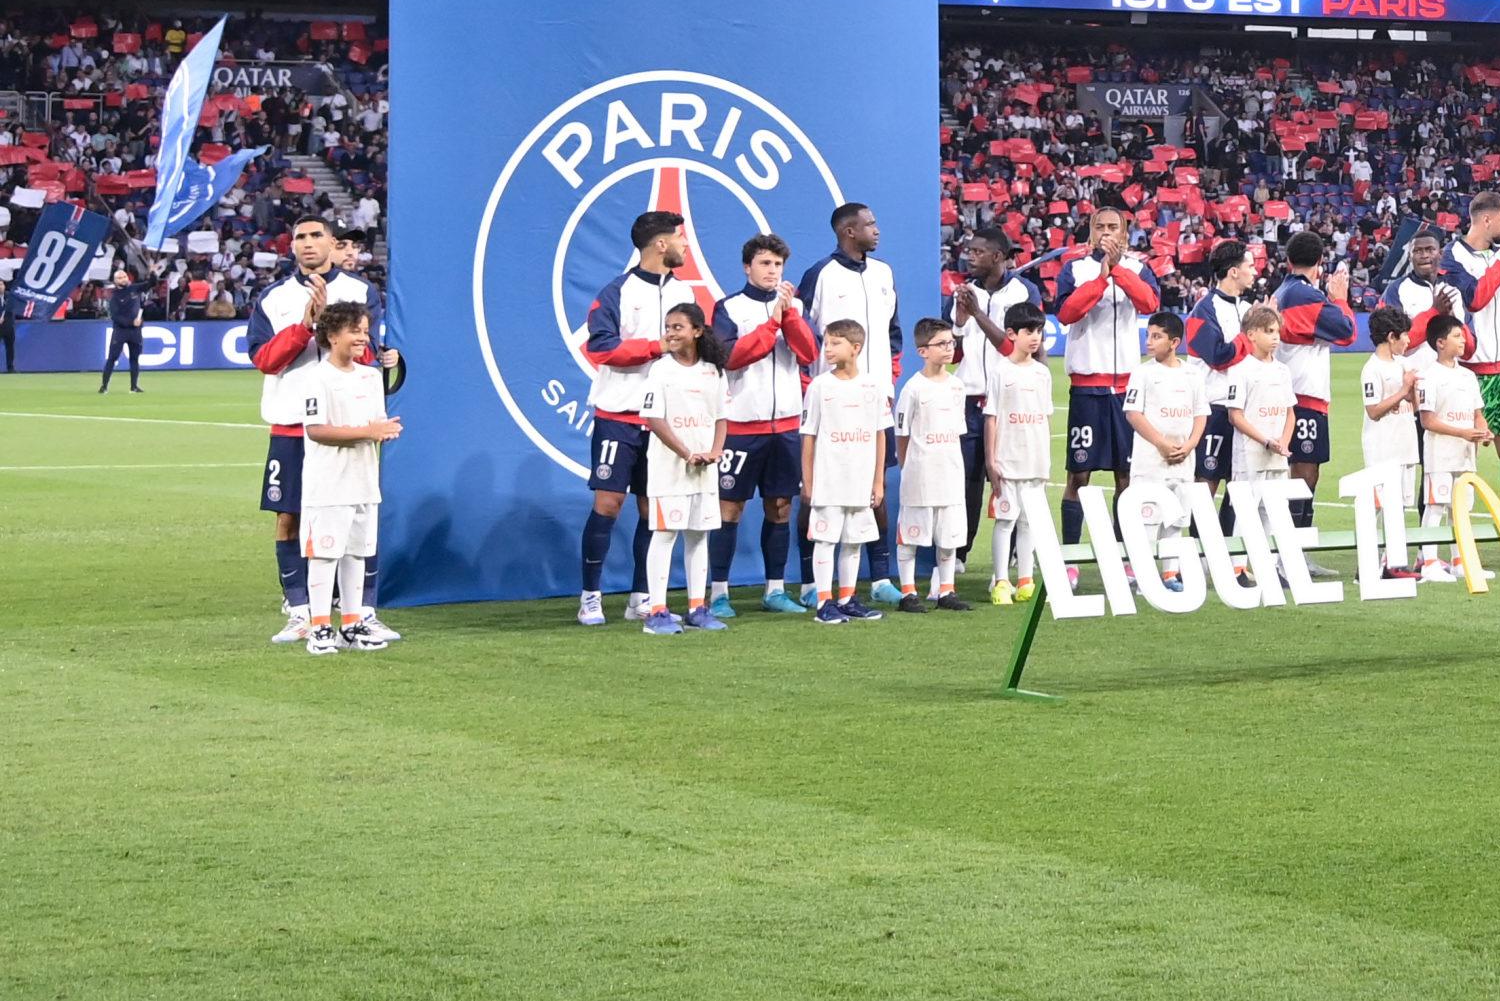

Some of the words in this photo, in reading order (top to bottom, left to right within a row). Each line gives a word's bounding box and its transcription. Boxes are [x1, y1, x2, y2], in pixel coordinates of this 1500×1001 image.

[213, 67, 292, 88] QATAR
[1105, 88, 1169, 108] QATAR
[1121, 105, 1169, 116] AIRWAYS
[541, 92, 793, 190] PARIS
[24, 231, 88, 294] 87
[830, 427, 872, 442] swile
[1071, 425, 1093, 449] 29
[1296, 418, 1318, 440] 33
[601, 439, 619, 465] 11
[1205, 434, 1224, 457] 17
[269, 459, 281, 486] 2
[719, 449, 748, 475] 87
[1020, 478, 1344, 620] LIGUE
